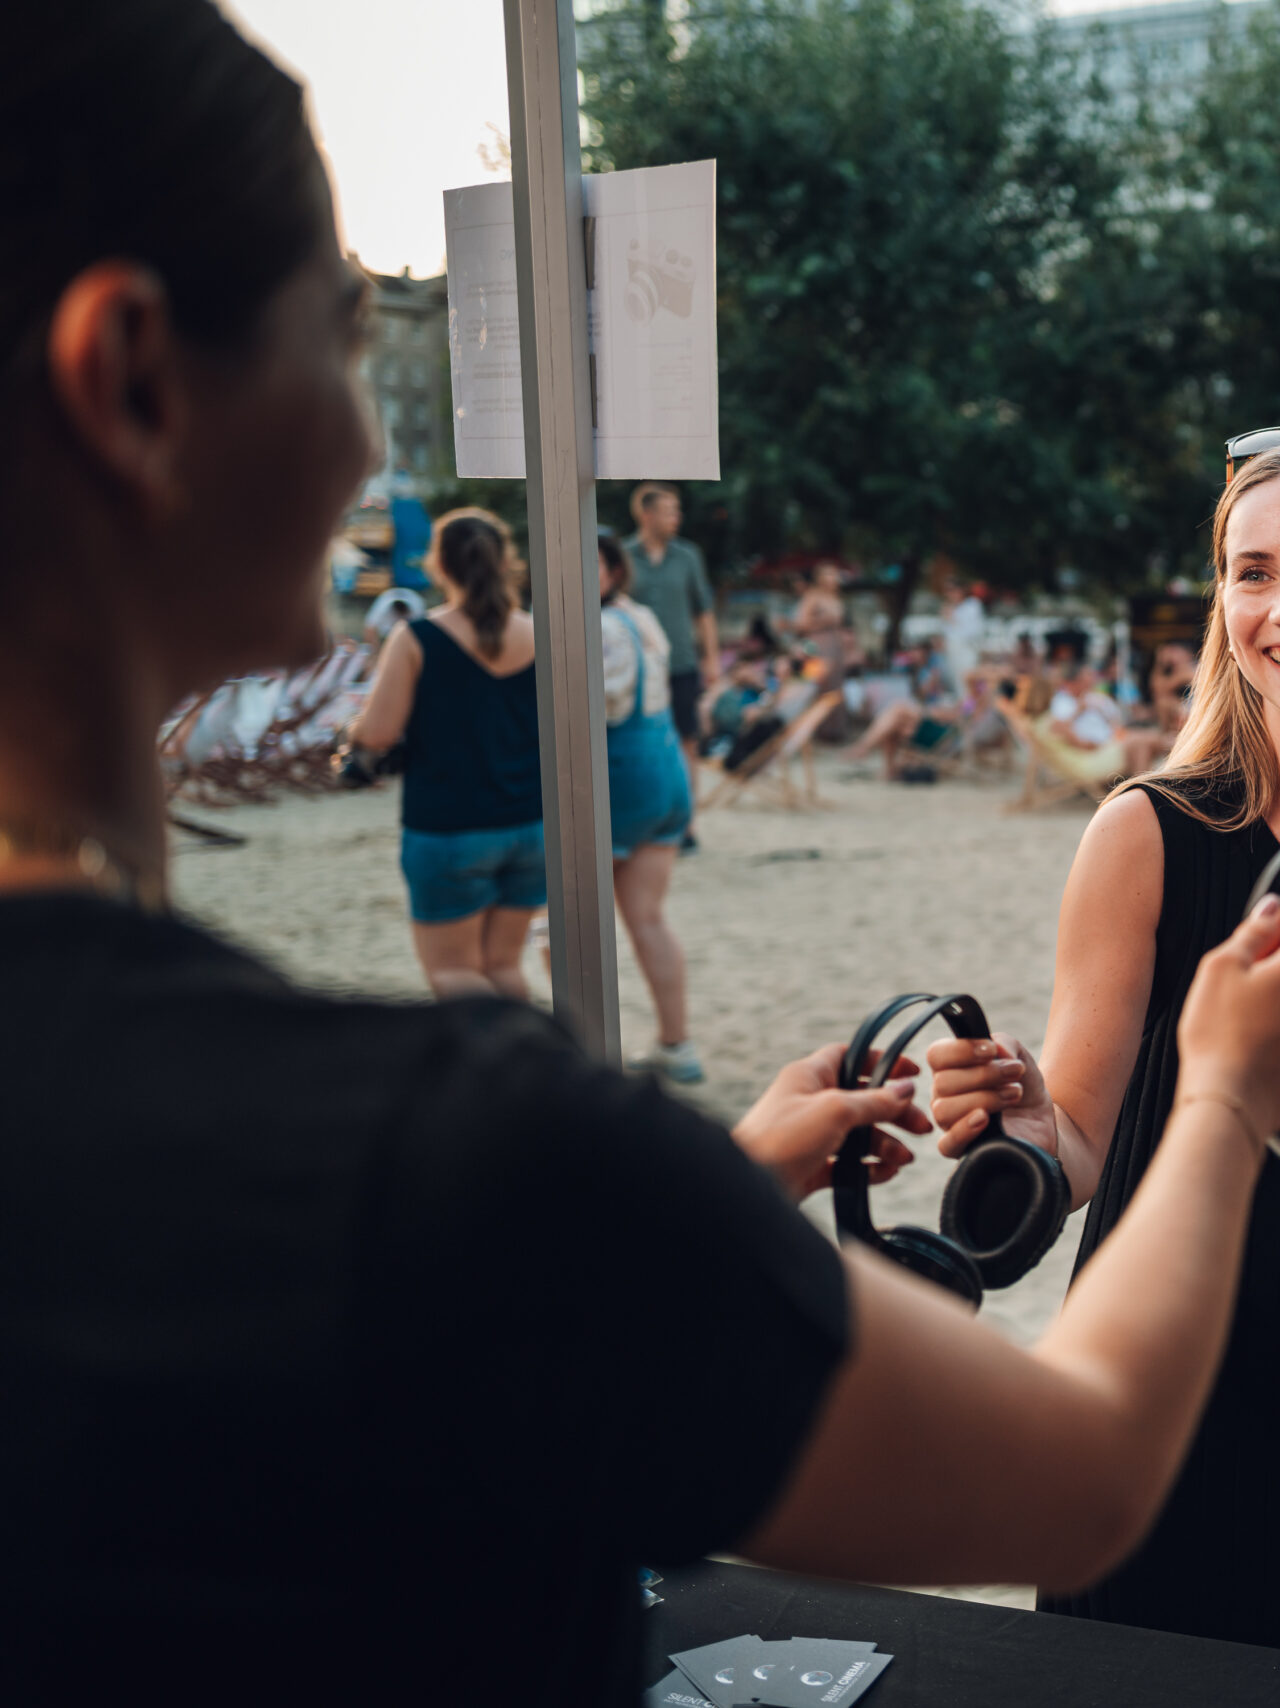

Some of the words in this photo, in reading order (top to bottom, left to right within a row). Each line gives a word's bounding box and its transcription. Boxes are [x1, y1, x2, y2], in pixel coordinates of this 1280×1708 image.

[820, 1683, 844, 1703] SILENT
[837, 1661, 866, 1686] CINEMA
[667, 1692, 704, 1706] SILENT
